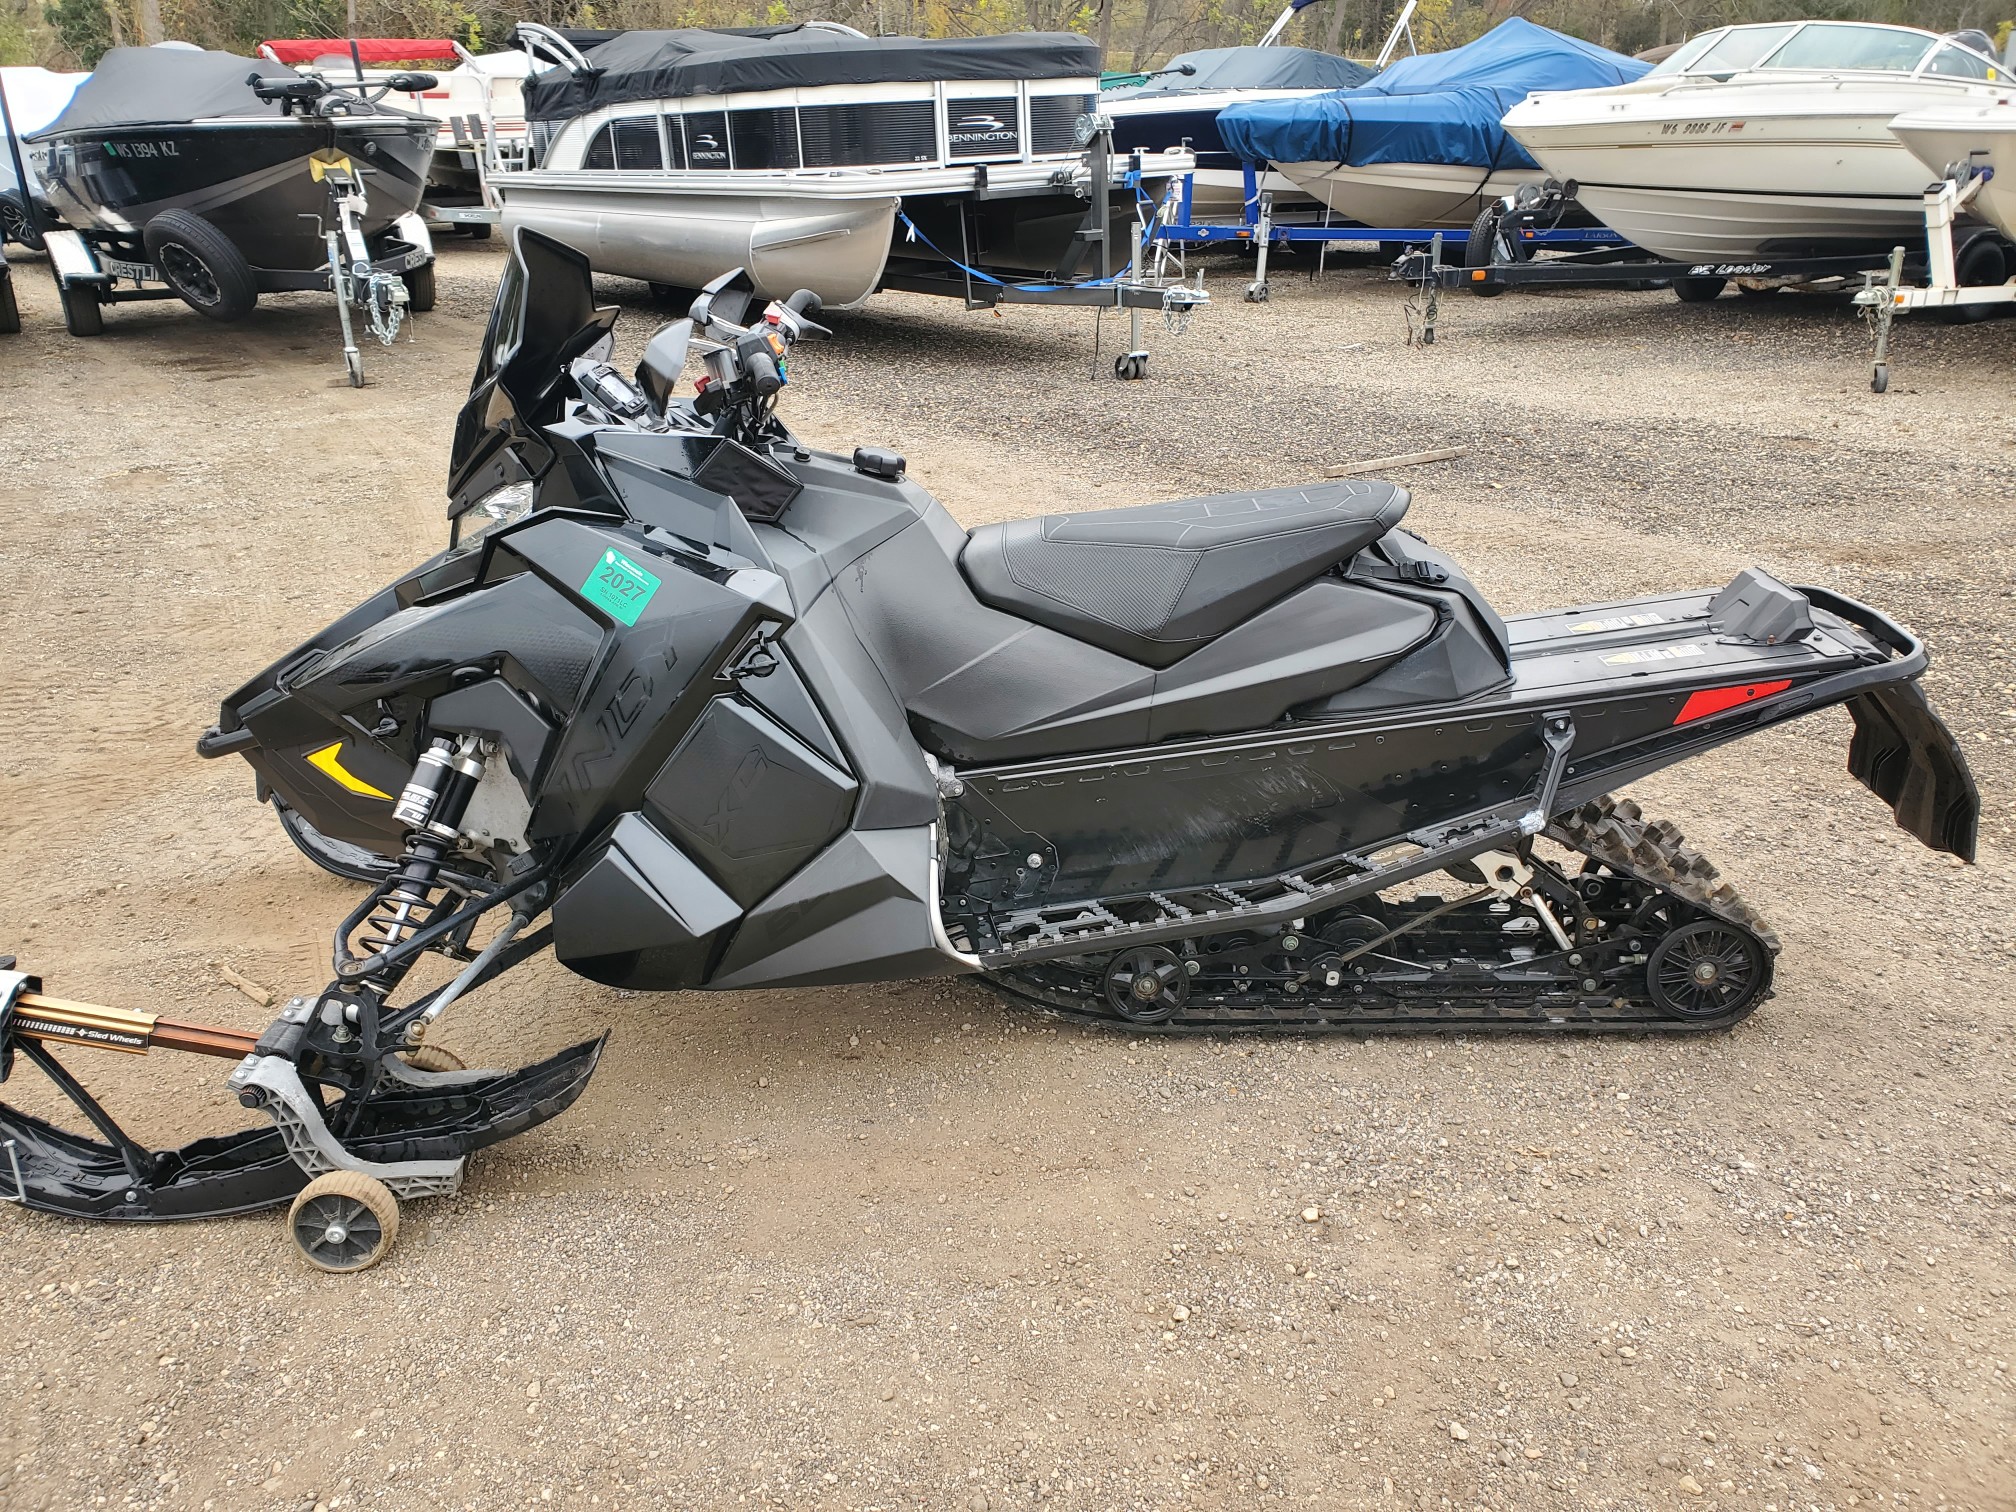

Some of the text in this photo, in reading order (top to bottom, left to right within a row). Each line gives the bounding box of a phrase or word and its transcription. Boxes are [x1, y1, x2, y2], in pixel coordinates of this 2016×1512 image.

[1661, 123, 1678, 135] WS
[1711, 122, 1728, 134] JF
[946, 131, 1018, 143] BENNINGTON
[114, 141, 180, 158] WS 1394 KZ
[691, 151, 727, 160] BENNINGTON
[599, 565, 647, 602] 2027
[87, 1030, 144, 1046] Sled Wheels
